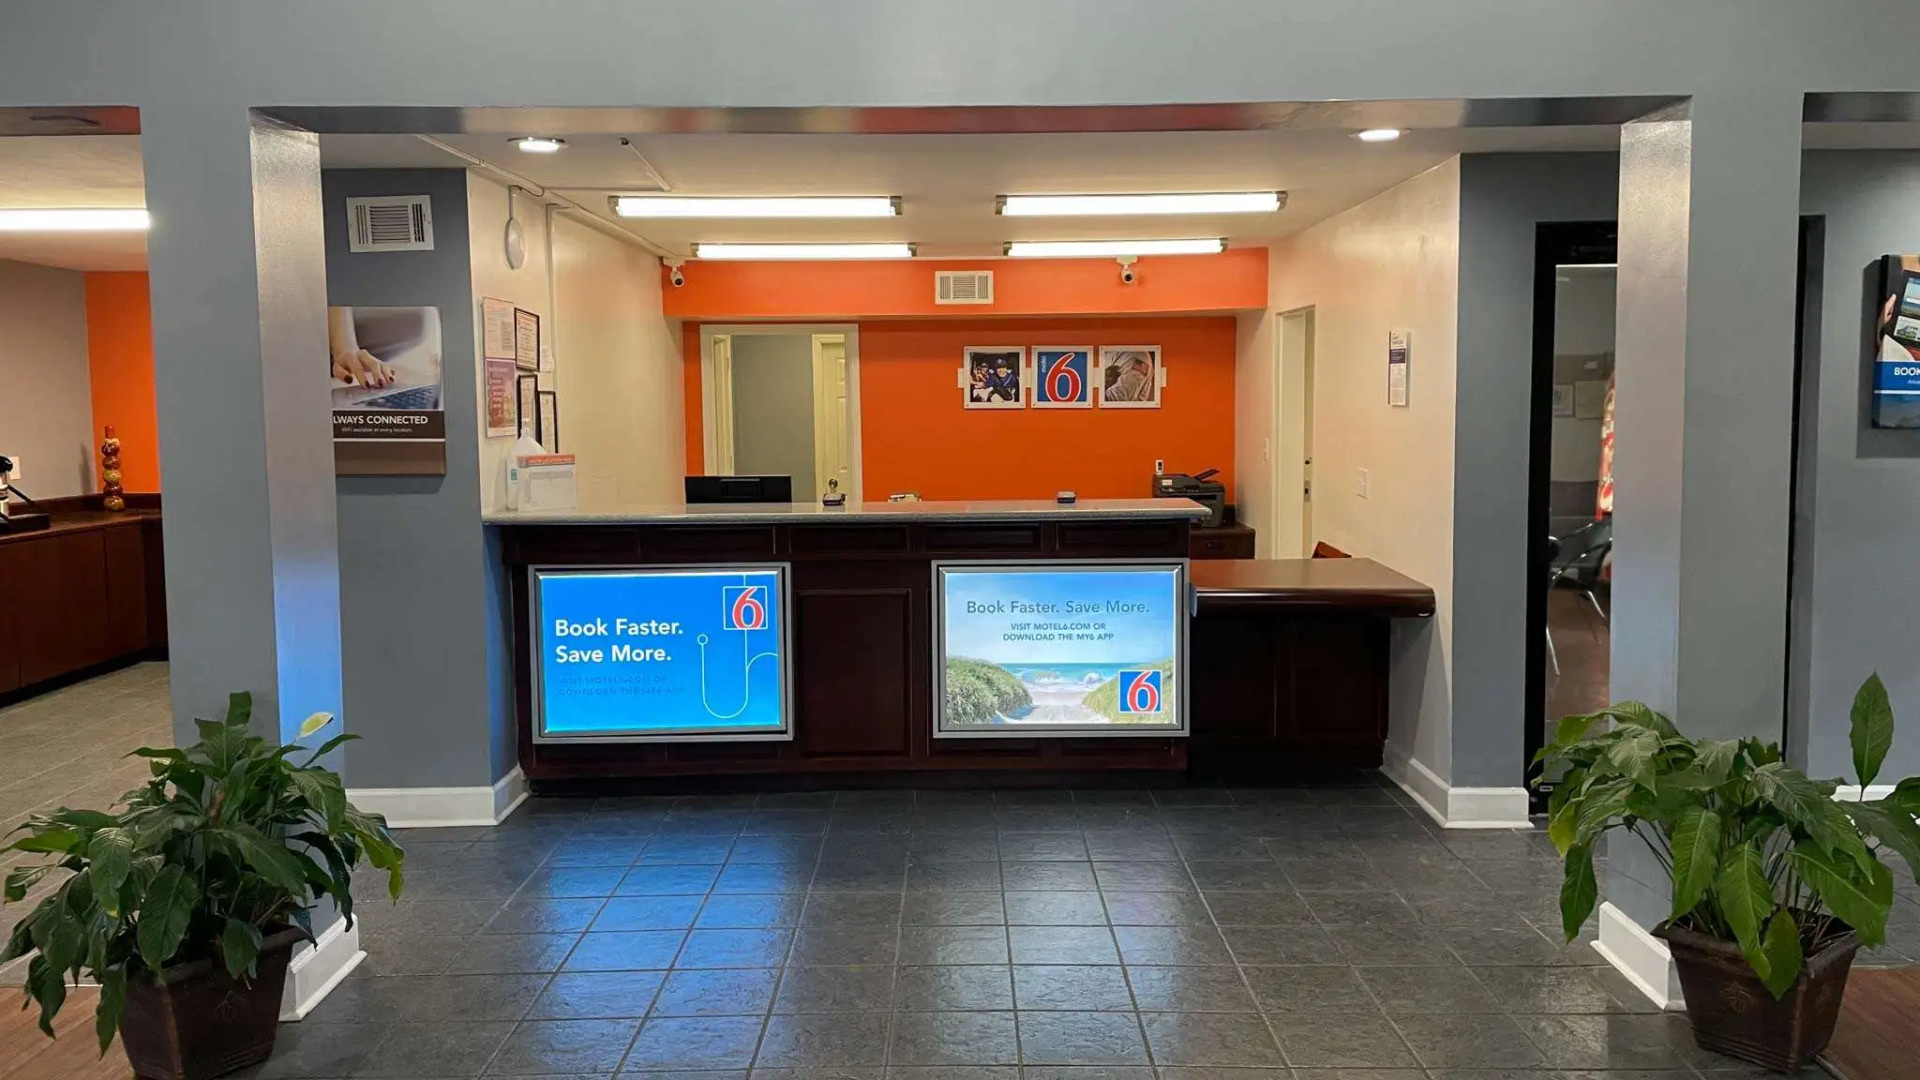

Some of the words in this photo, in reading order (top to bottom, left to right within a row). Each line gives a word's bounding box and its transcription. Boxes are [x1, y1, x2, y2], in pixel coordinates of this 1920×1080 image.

[1045, 353, 1081, 402] 6
[333, 415, 364, 425] LWAYS
[366, 415, 429, 425] CONNECTED
[732, 587, 764, 629] 6
[967, 600, 1006, 614] Book
[1010, 601, 1060, 613] Faster.
[1066, 601, 1100, 613] Save
[1106, 600, 1150, 613] More.
[555, 617, 609, 637] Book
[615, 618, 684, 636] Faster.
[1093, 622, 1107, 630] OR
[1003, 633, 1055, 641] DOWNLOAD
[1058, 633, 1074, 641] THE
[1076, 633, 1095, 641] MY6
[1097, 633, 1114, 641] APP
[555, 645, 604, 663] Save
[611, 644, 672, 662] More.
[1126, 670, 1159, 712] 6
